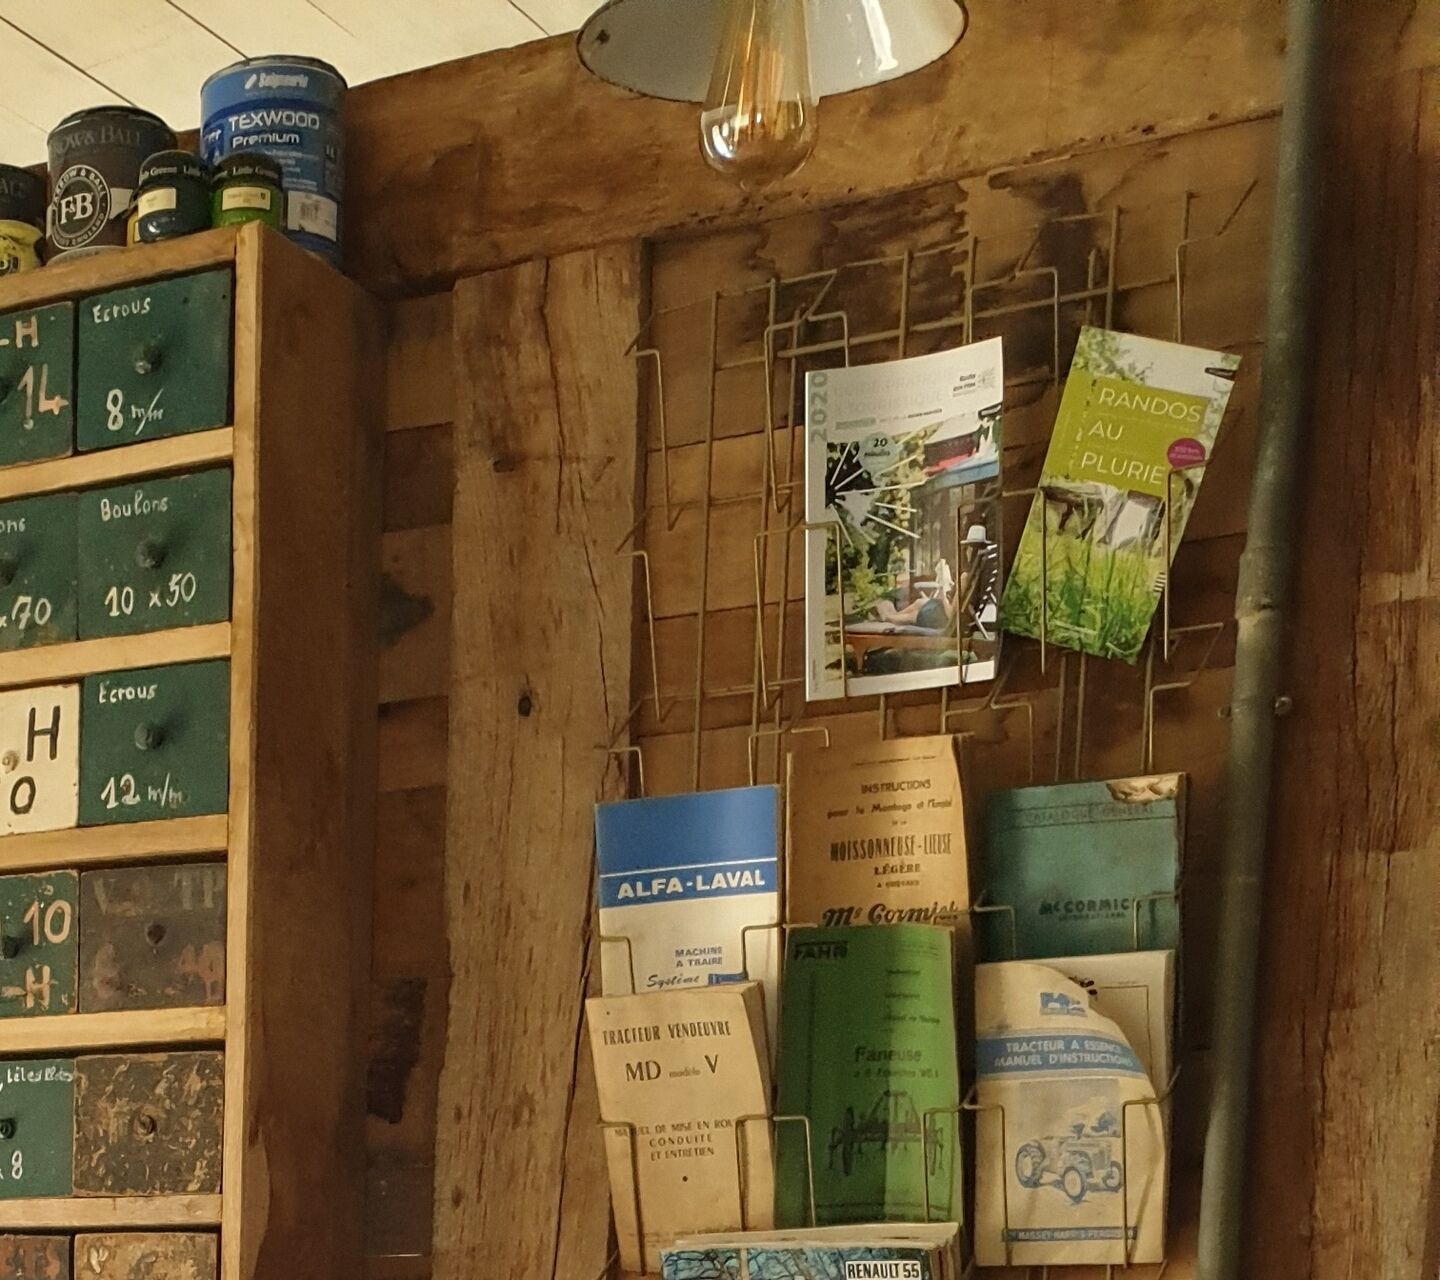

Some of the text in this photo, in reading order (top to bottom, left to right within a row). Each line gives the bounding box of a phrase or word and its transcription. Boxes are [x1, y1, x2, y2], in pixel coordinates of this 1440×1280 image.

[229, 110, 321, 132] TEXWOOD
[232, 132, 301, 149] Premium
[60, 192, 95, 225] F&B
[92, 297, 151, 324] Ecrous
[106, 388, 124, 431] 8
[1098, 386, 1204, 423] RANDOS
[1088, 419, 1124, 441] AU
[100, 489, 170, 522] Boulons
[104, 586, 134, 617] 10
[166, 571, 197, 607] 50
[26, 705, 61, 763] H
[100, 773, 140, 809] 12
[861, 778, 932, 795] INSTRUCTIONS
[23, 899, 71, 946] 10
[603, 1020, 732, 1046] TRACTEUR VENDEUVRE
[1006, 1040, 1065, 1053] TRACTEUR
[625, 1059, 661, 1082] MD
[704, 1054, 719, 1074] V
[994, 1054, 1042, 1066] MANUEL
[649, 1133, 713, 1148] CONDUITE
[12, 1150, 23, 1180] 8
[848, 1263, 920, 1279] RENAULT 55
